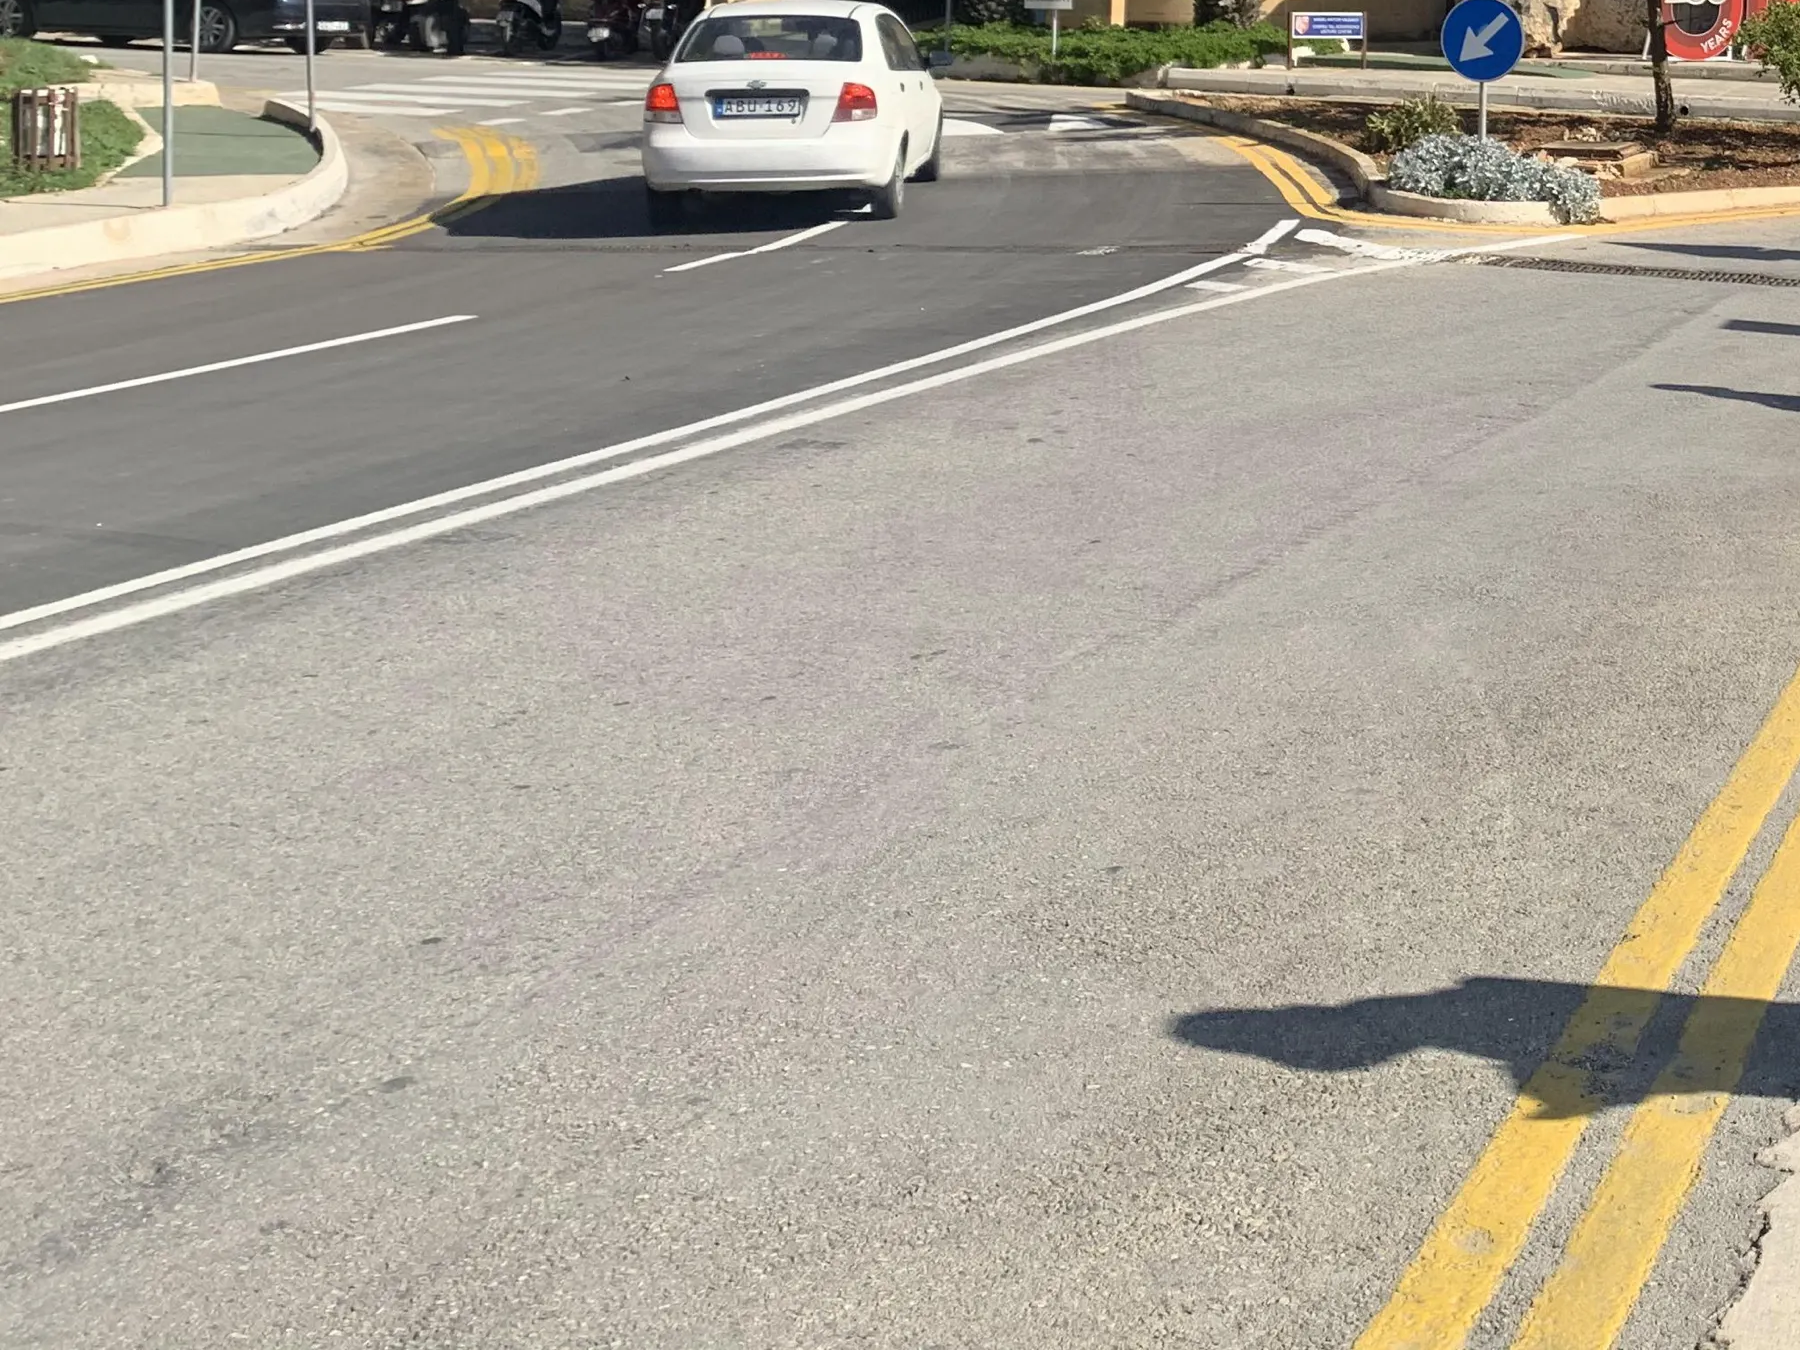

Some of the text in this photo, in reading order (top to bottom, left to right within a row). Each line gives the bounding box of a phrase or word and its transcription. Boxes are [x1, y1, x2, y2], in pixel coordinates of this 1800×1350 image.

[1700, 18, 1733, 53] YEARS
[724, 99, 797, 113] ABU 169
